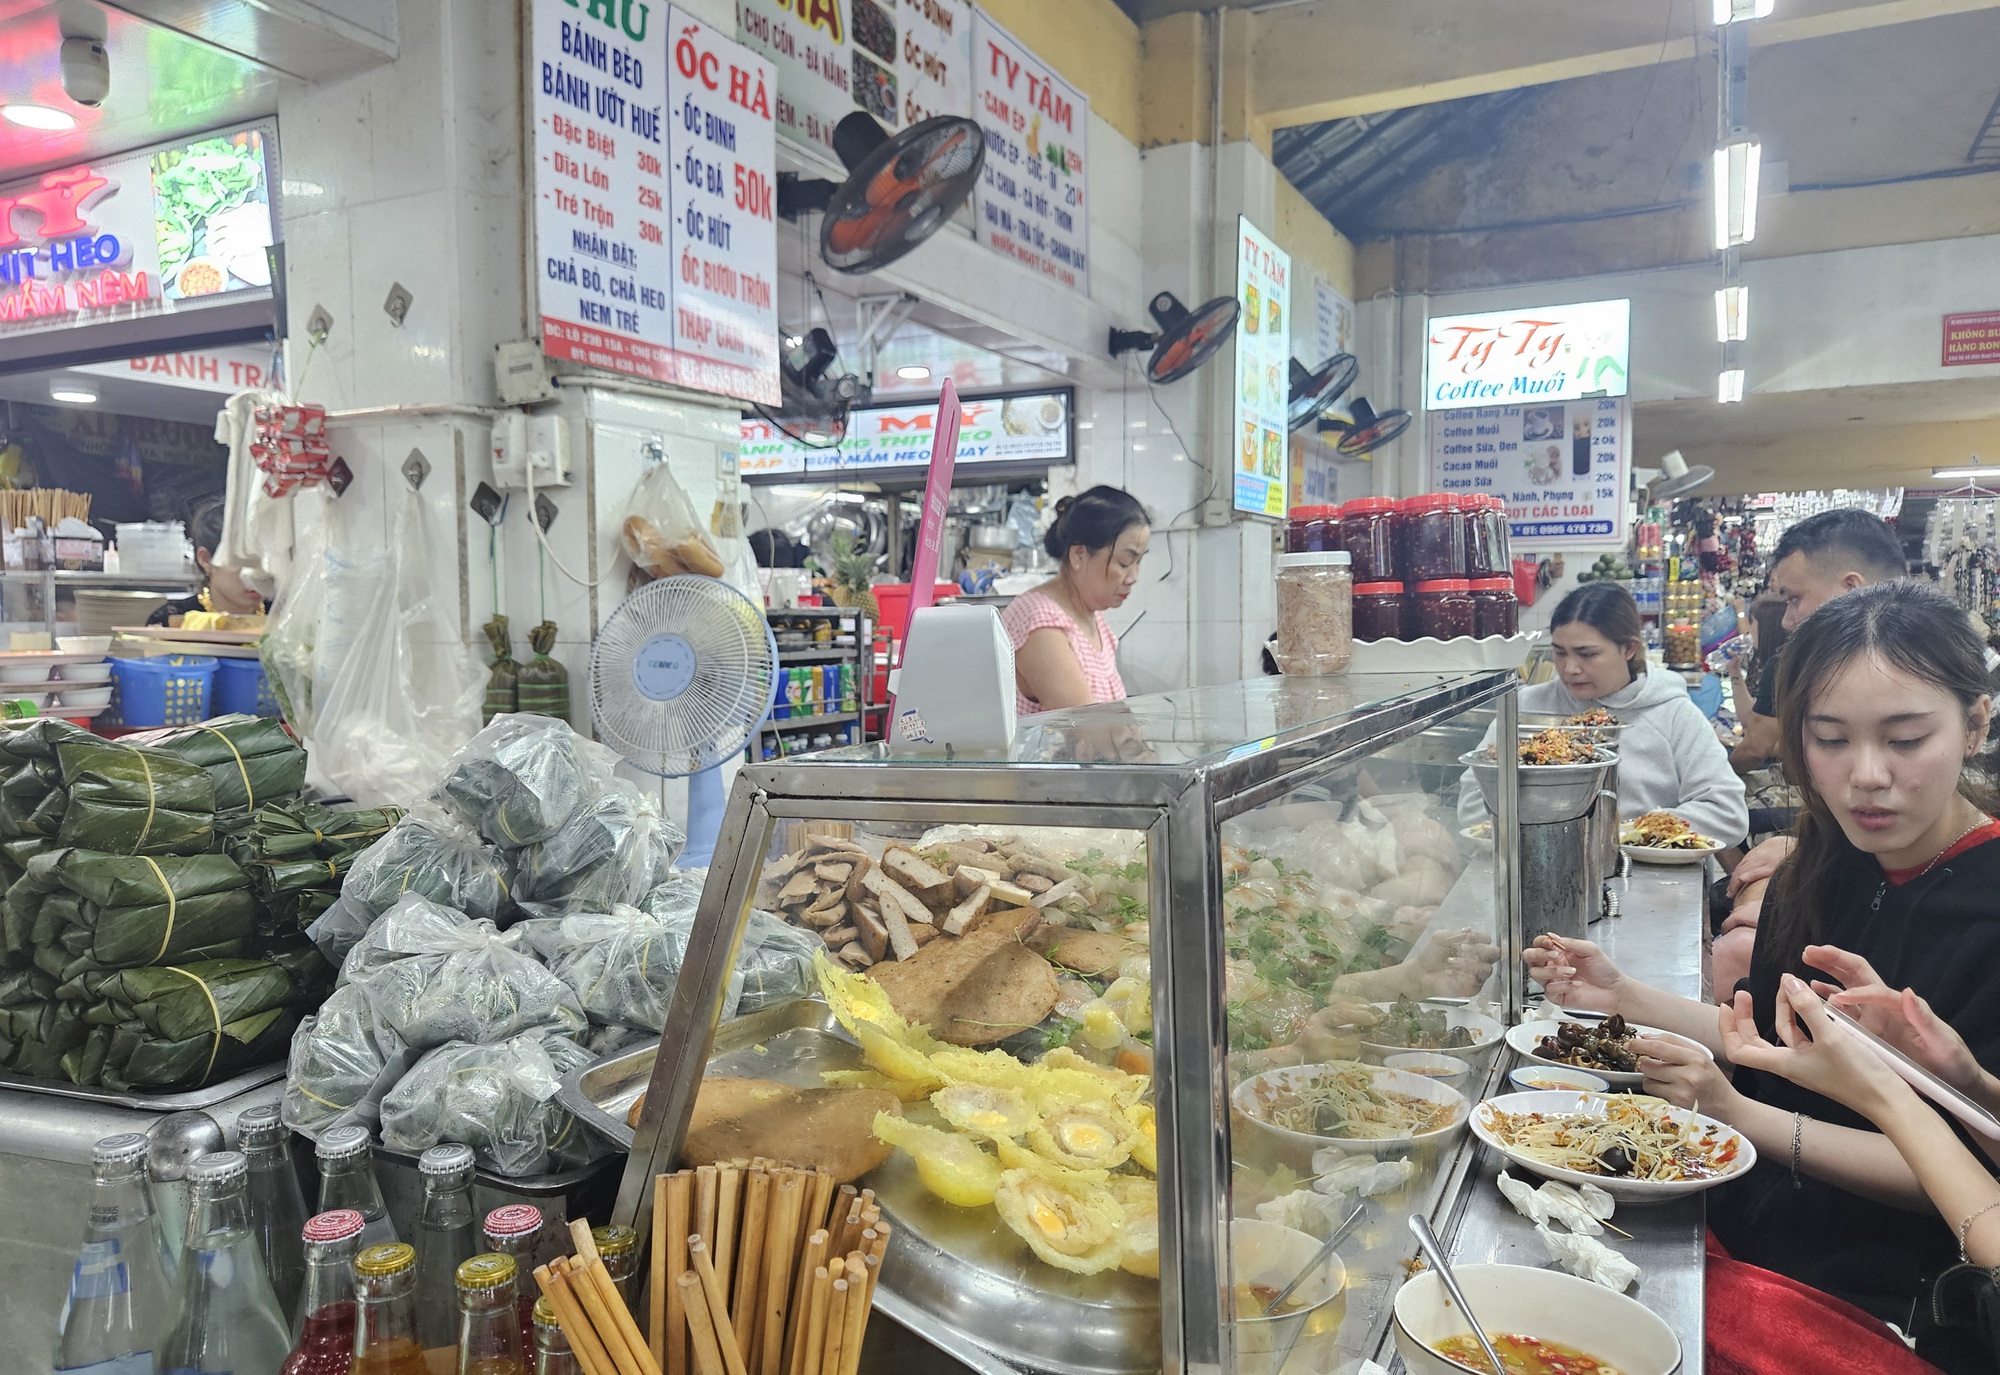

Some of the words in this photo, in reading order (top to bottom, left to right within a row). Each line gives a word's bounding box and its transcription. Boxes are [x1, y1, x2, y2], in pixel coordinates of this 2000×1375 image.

[562, 20, 607, 73] BÁNH
[613, 46, 643, 89] BÈO
[676, 24, 720, 91] ỐC
[728, 62, 772, 122] HÀ
[542, 61, 590, 113] BÁNH
[596, 86, 626, 128] ƯỚT
[631, 103, 661, 144] HUẾ
[987, 39, 1019, 89] TY
[1025, 70, 1071, 133] TÂM
[684, 92, 702, 136] ỐC
[553, 113, 582, 145] Đặc
[586, 128, 615, 160] Biệt
[637, 150, 662, 178] 30k
[685, 145, 703, 189] ỐC
[707, 162, 725, 199] ĐÁ
[583, 161, 609, 191] Lớn
[638, 185, 663, 212] 25k
[554, 188, 578, 215] Tré
[582, 198, 615, 229] Trộn
[638, 219, 664, 246] 30k
[686, 198, 704, 241] ỐC
[708, 214, 732, 252] HÚT
[51, 234, 120, 272] HEO
[681, 245, 699, 287] ỐC
[75, 269, 149, 309] NÊM
[547, 257, 578, 286] CHẢ
[610, 274, 637, 303] CHẢ
[640, 287, 666, 311] HEO
[579, 298, 612, 327] NEM
[616, 310, 640, 334] TRÉ
[1436, 379, 1504, 402] Coffee
[1508, 371, 1566, 396] Muối
[1532, 503, 1559, 519] CÁC
[1563, 504, 1594, 520] LOẠI
